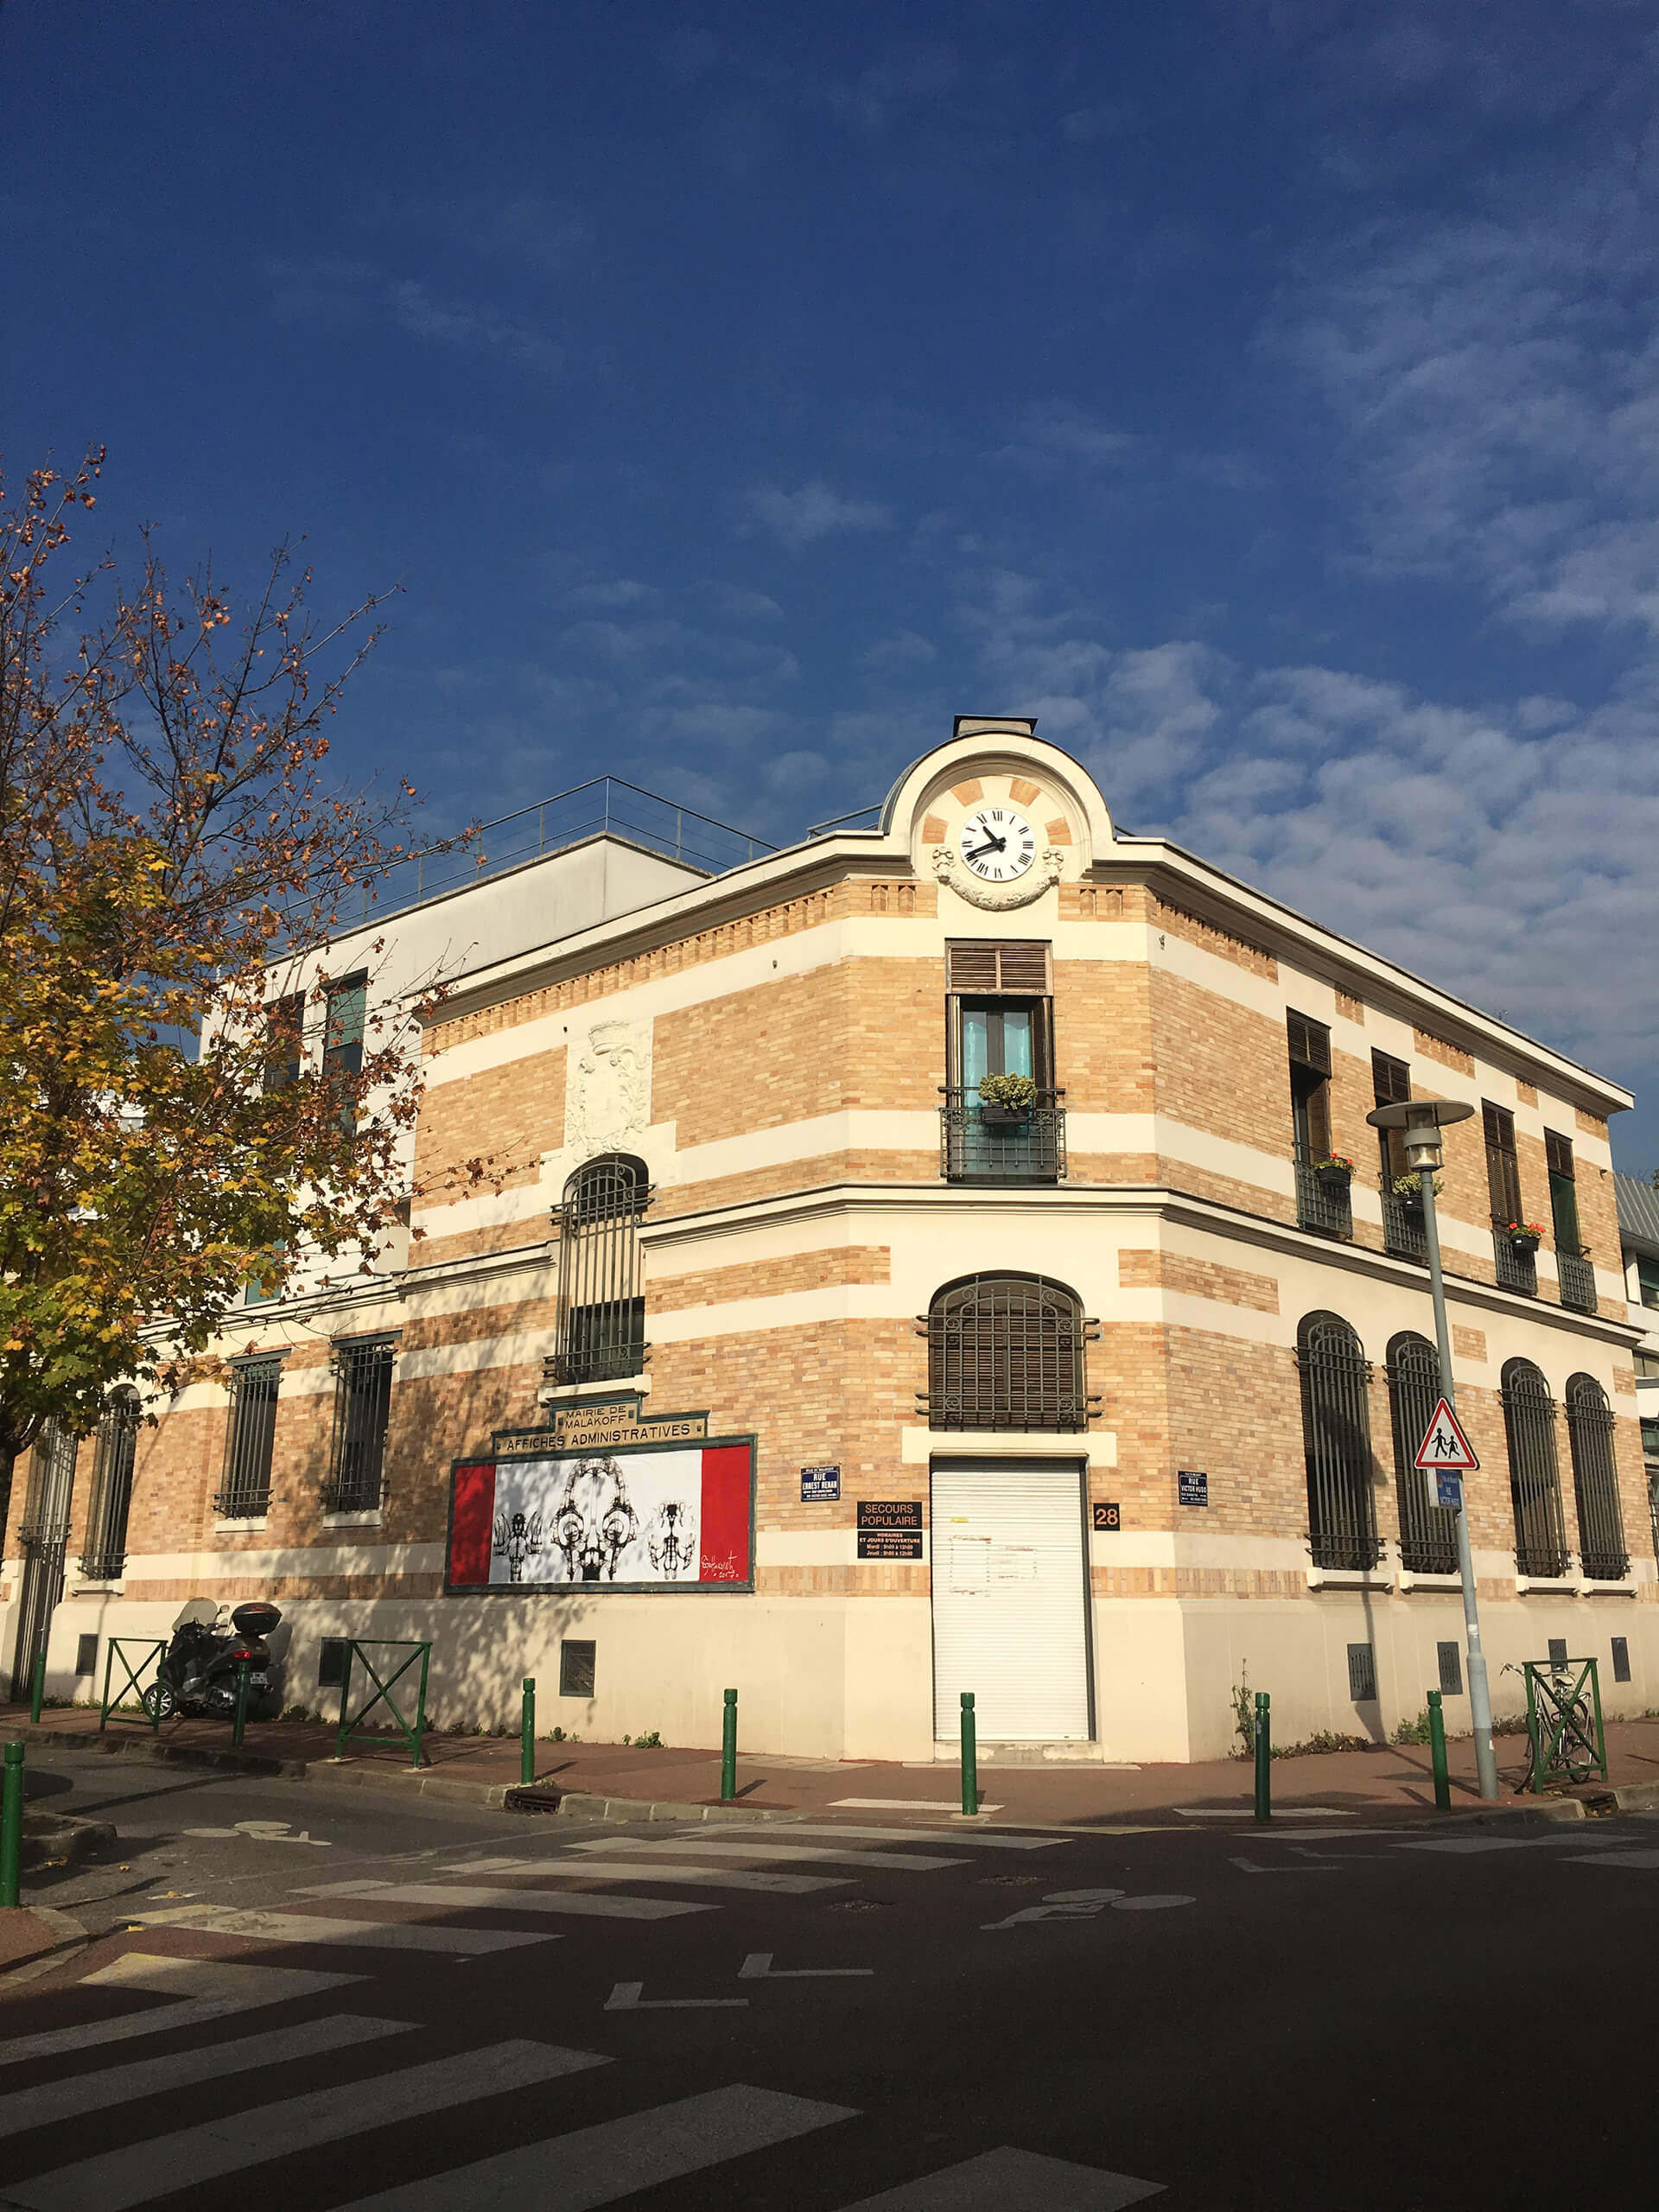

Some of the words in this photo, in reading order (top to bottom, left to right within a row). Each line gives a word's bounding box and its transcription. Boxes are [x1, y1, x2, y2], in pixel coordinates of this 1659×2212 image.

[566, 1408, 605, 1419] MAIRIE
[610, 1406, 626, 1414] DE
[565, 1415, 626, 1429] MALAKOFF
[506, 1436, 565, 1452] AFFICHES
[571, 1424, 690, 1446] ADMINISTRATIVES
[813, 1472, 826, 1481] RUE
[865, 1504, 913, 1514] SECOURS
[861, 1516, 918, 1526] POPULAIRE
[1096, 1508, 1118, 1526] 28
